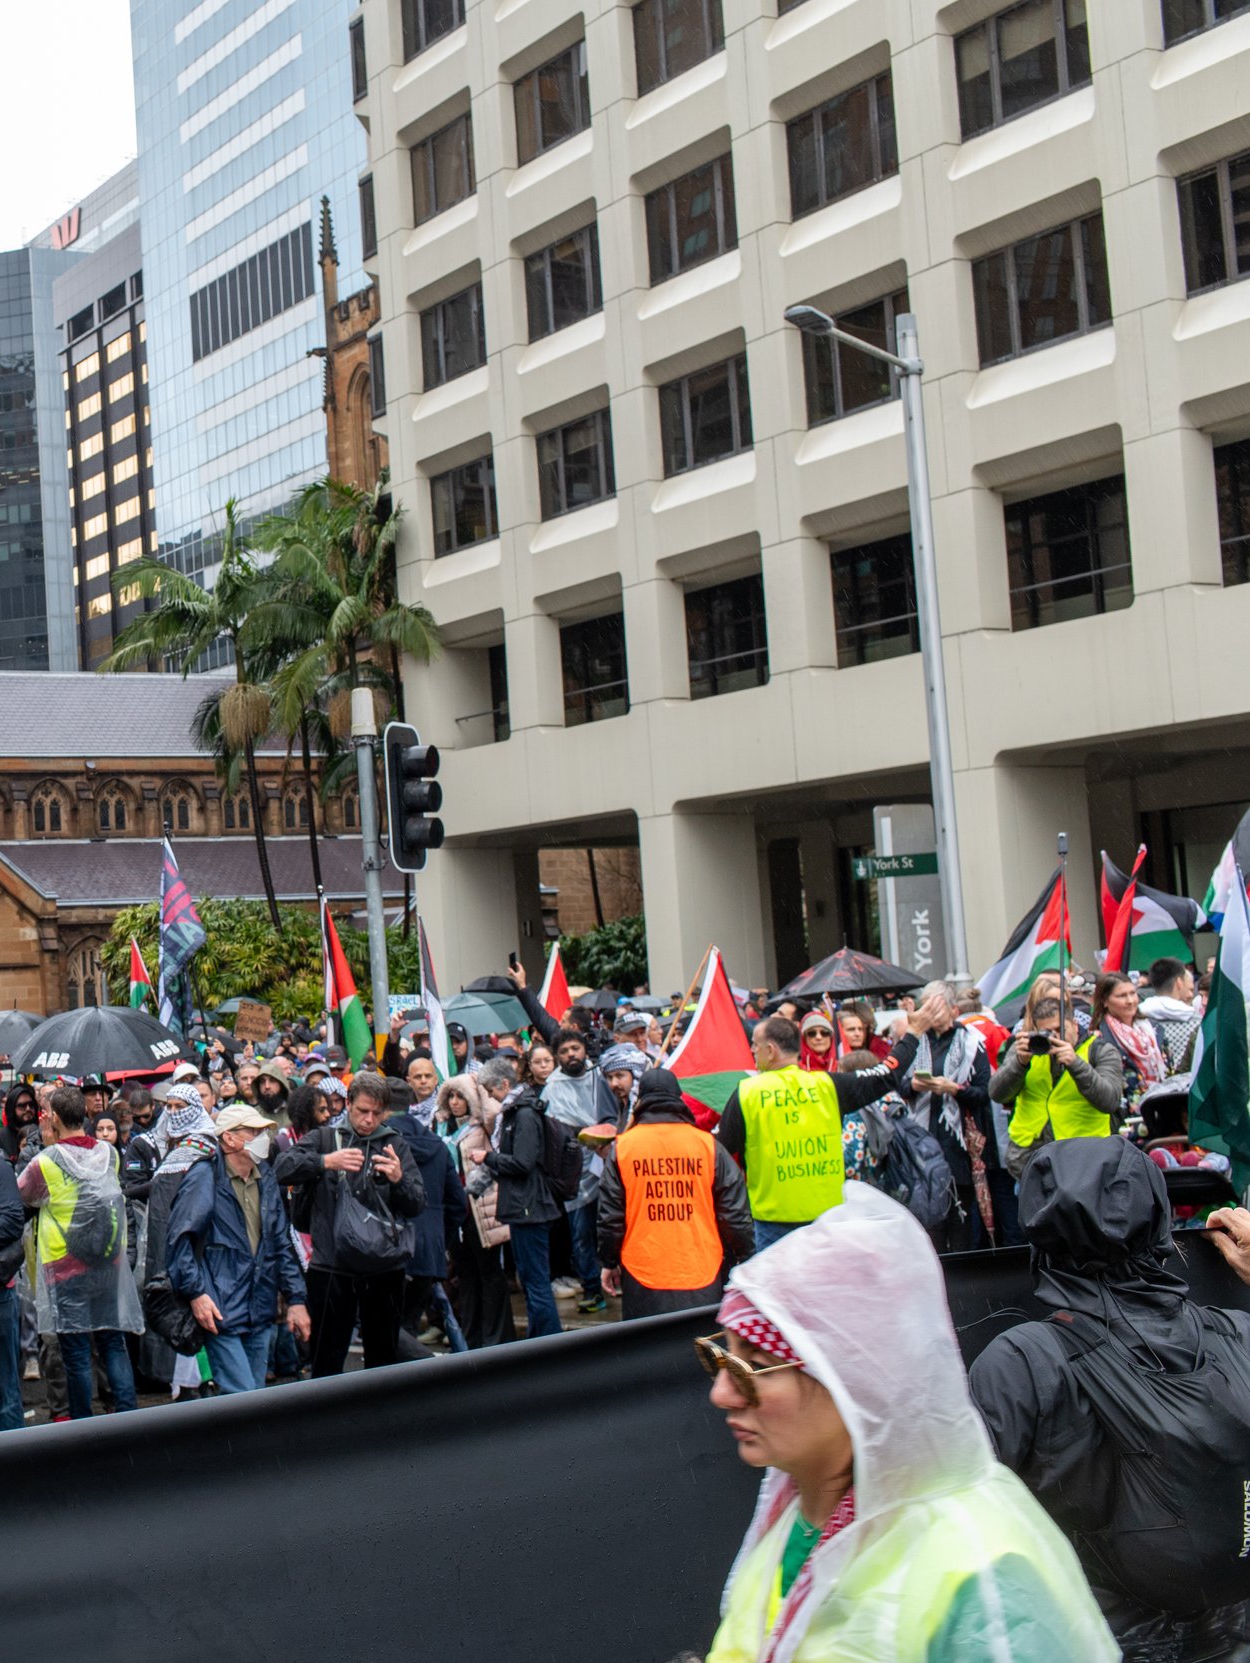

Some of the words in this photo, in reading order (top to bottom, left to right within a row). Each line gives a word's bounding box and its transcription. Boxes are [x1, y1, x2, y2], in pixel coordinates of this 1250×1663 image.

[873, 857, 900, 871] York
[901, 856, 915, 869] St
[911, 909, 933, 971] York
[32, 1052, 70, 1068] ABB
[150, 1040, 180, 1060] ABB
[760, 1087, 820, 1108] PEACE
[785, 1111, 800, 1125] IS
[775, 1134, 828, 1159] UNION
[632, 1157, 703, 1177] PALESTINE
[776, 1158, 842, 1183] BUSINESS
[645, 1180, 694, 1199] ACTION
[647, 1203, 694, 1222] GROUP
